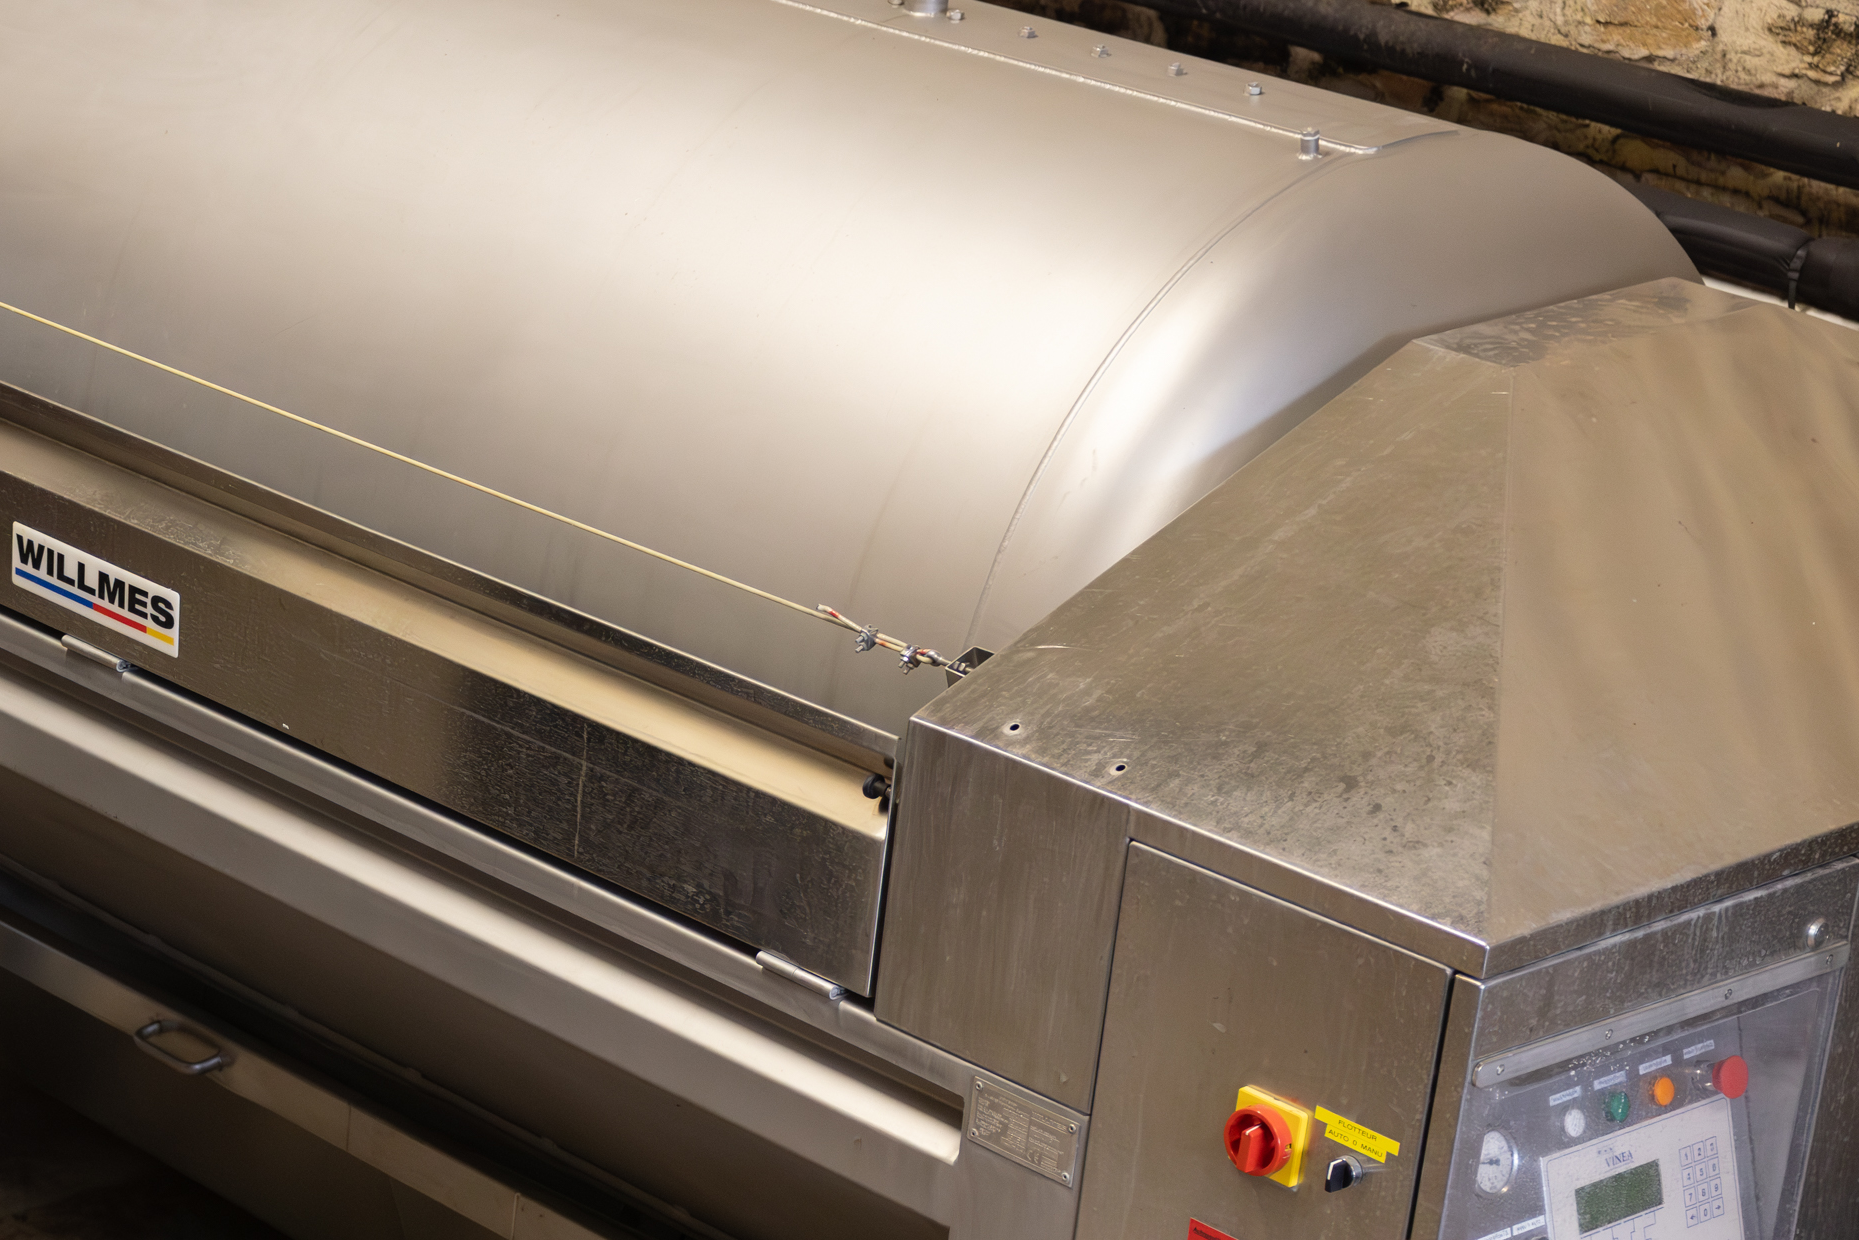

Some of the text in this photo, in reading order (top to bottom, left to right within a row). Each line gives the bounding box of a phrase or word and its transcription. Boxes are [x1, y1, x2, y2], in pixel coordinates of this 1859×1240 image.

[16, 533, 174, 630] WILLMES
[1328, 1129, 1349, 1142] AUTO
[1360, 1143, 1383, 1158] MANU
[1338, 1119, 1377, 1142] FLOTTEUR
[1605, 1150, 1633, 1167] VINEA
